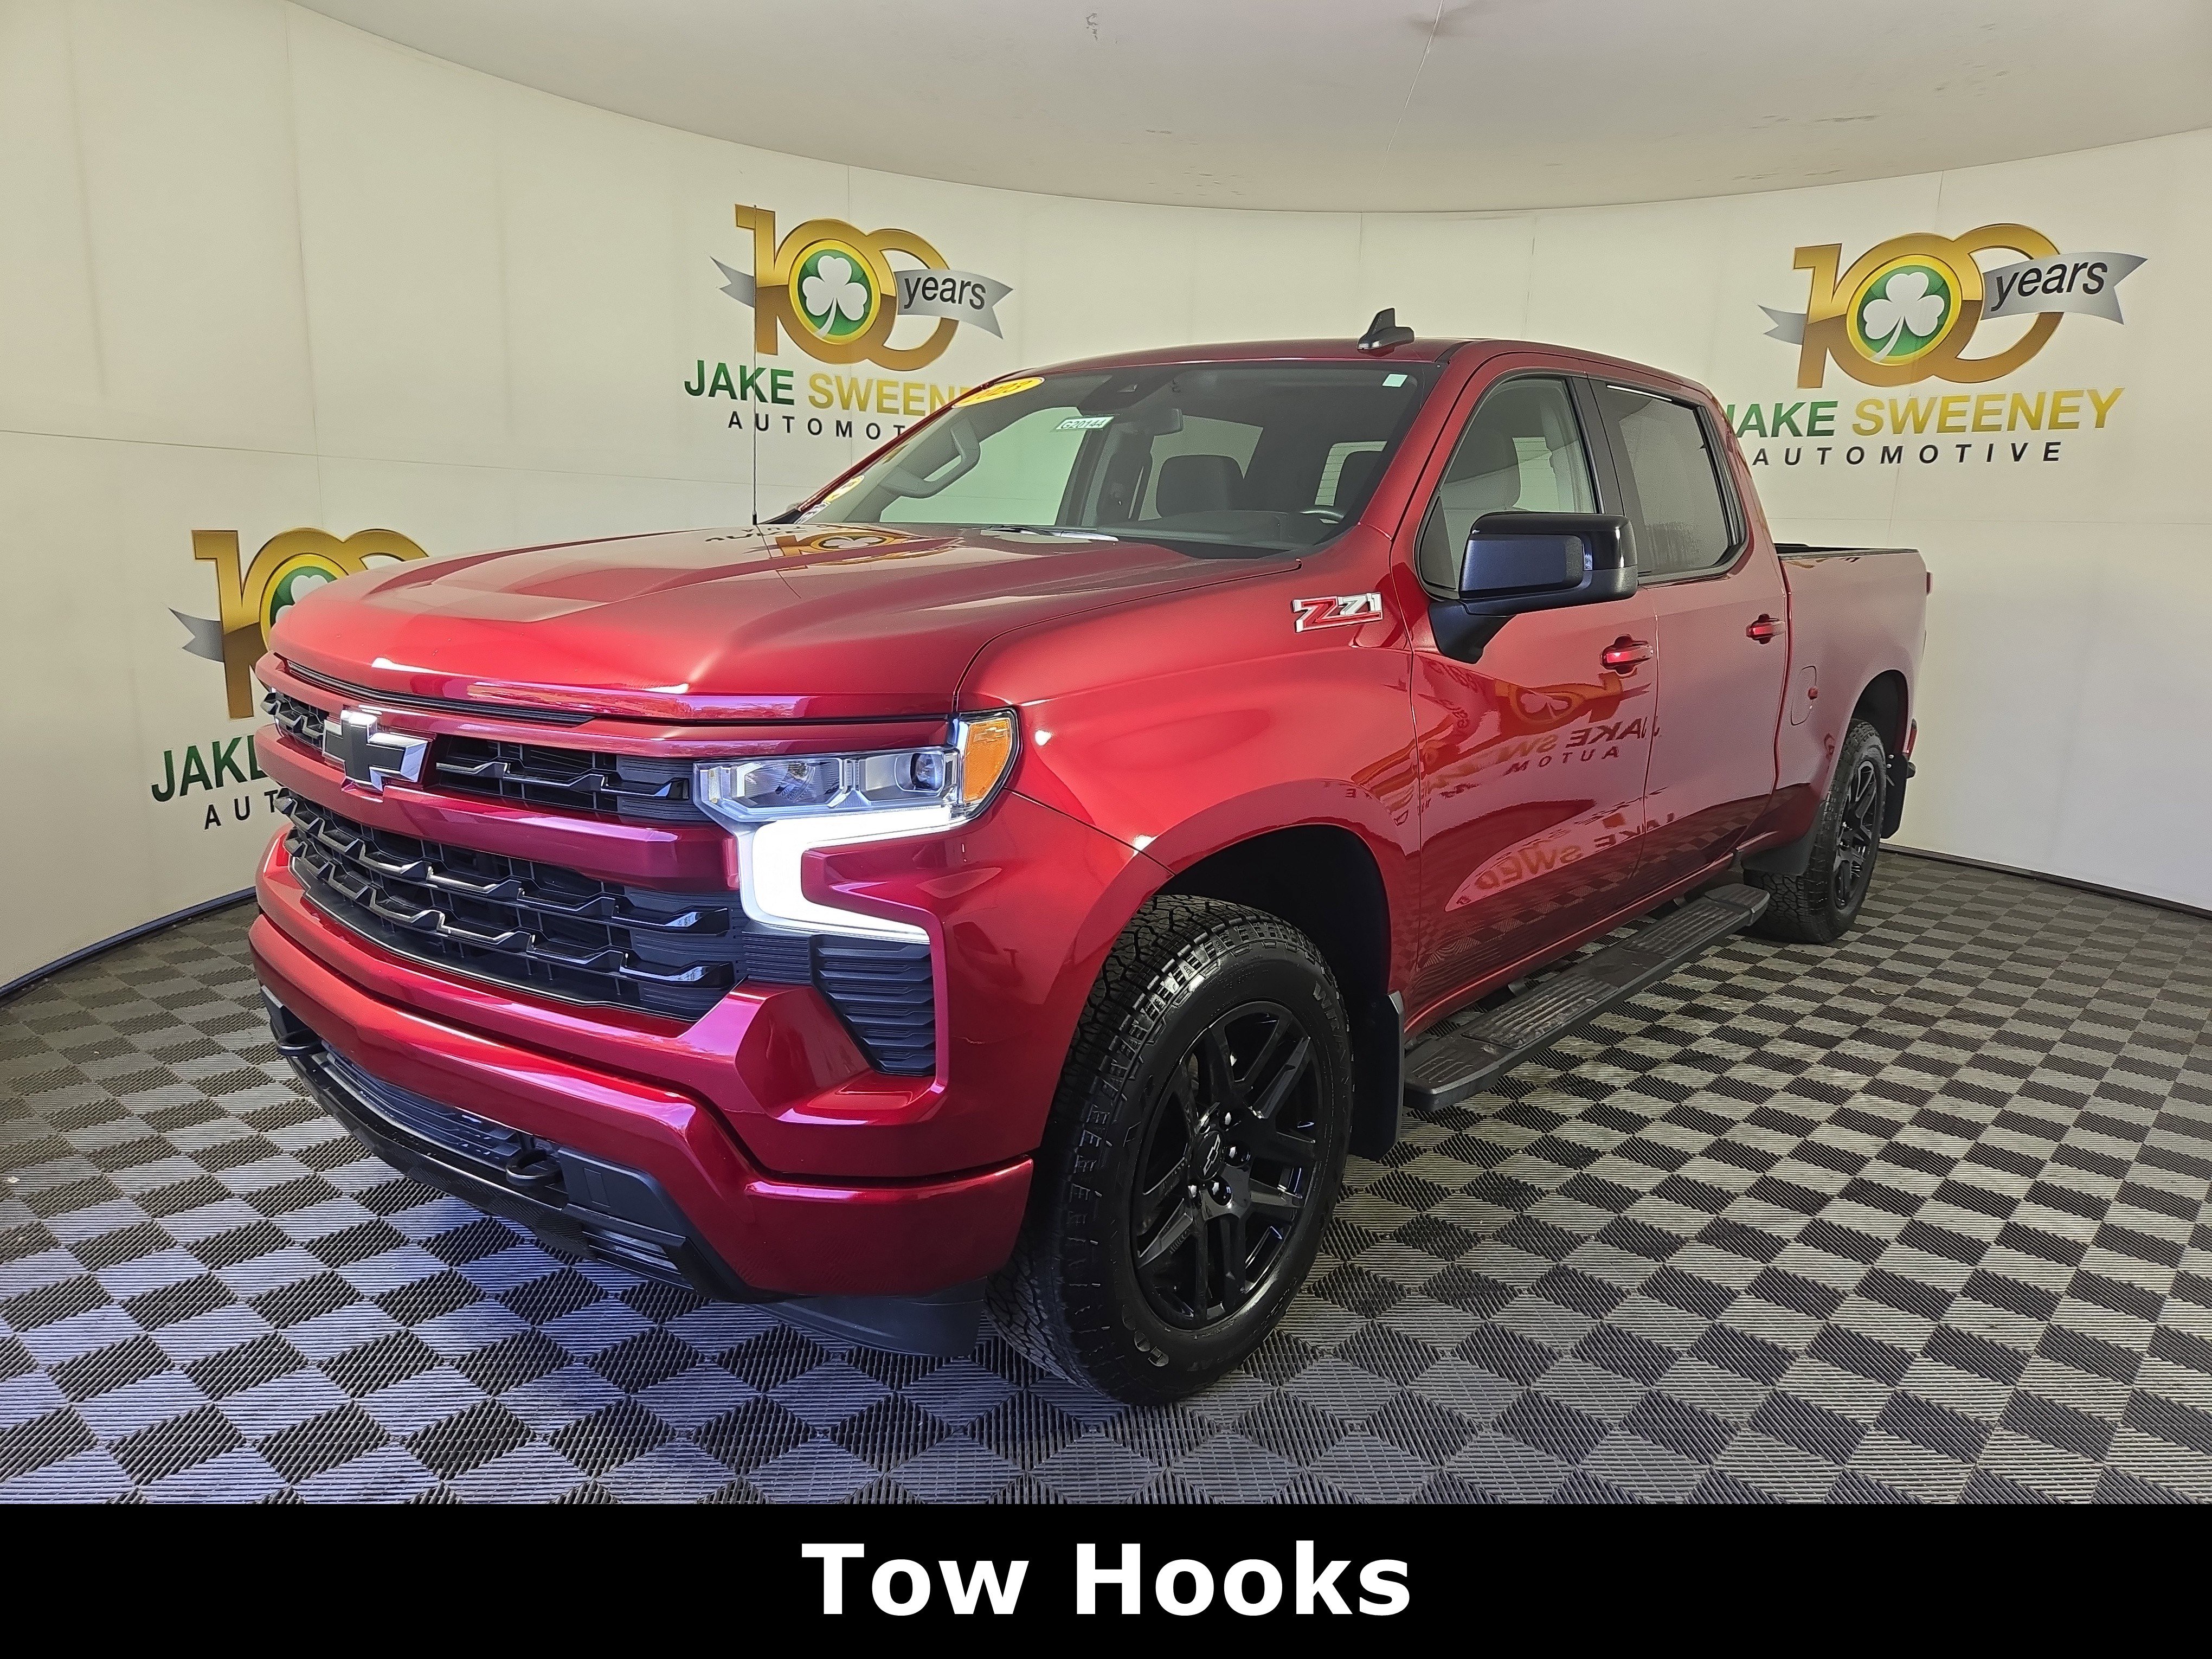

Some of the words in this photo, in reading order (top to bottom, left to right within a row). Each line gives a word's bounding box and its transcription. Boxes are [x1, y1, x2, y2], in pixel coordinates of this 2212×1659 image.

[735, 204, 960, 371] 100
[904, 276, 986, 310] years
[1793, 223, 2064, 389] 100
[1990, 261, 2108, 312] years
[684, 359, 794, 406] JAKE
[808, 373, 972, 416] SWEEN
[1852, 388, 2125, 436] SWEENEY
[1060, 419, 1107, 429] G20144
[1752, 441, 2062, 466] AUTOMOTIVE
[192, 527, 429, 719] 10
[1293, 592, 1383, 633] Z71
